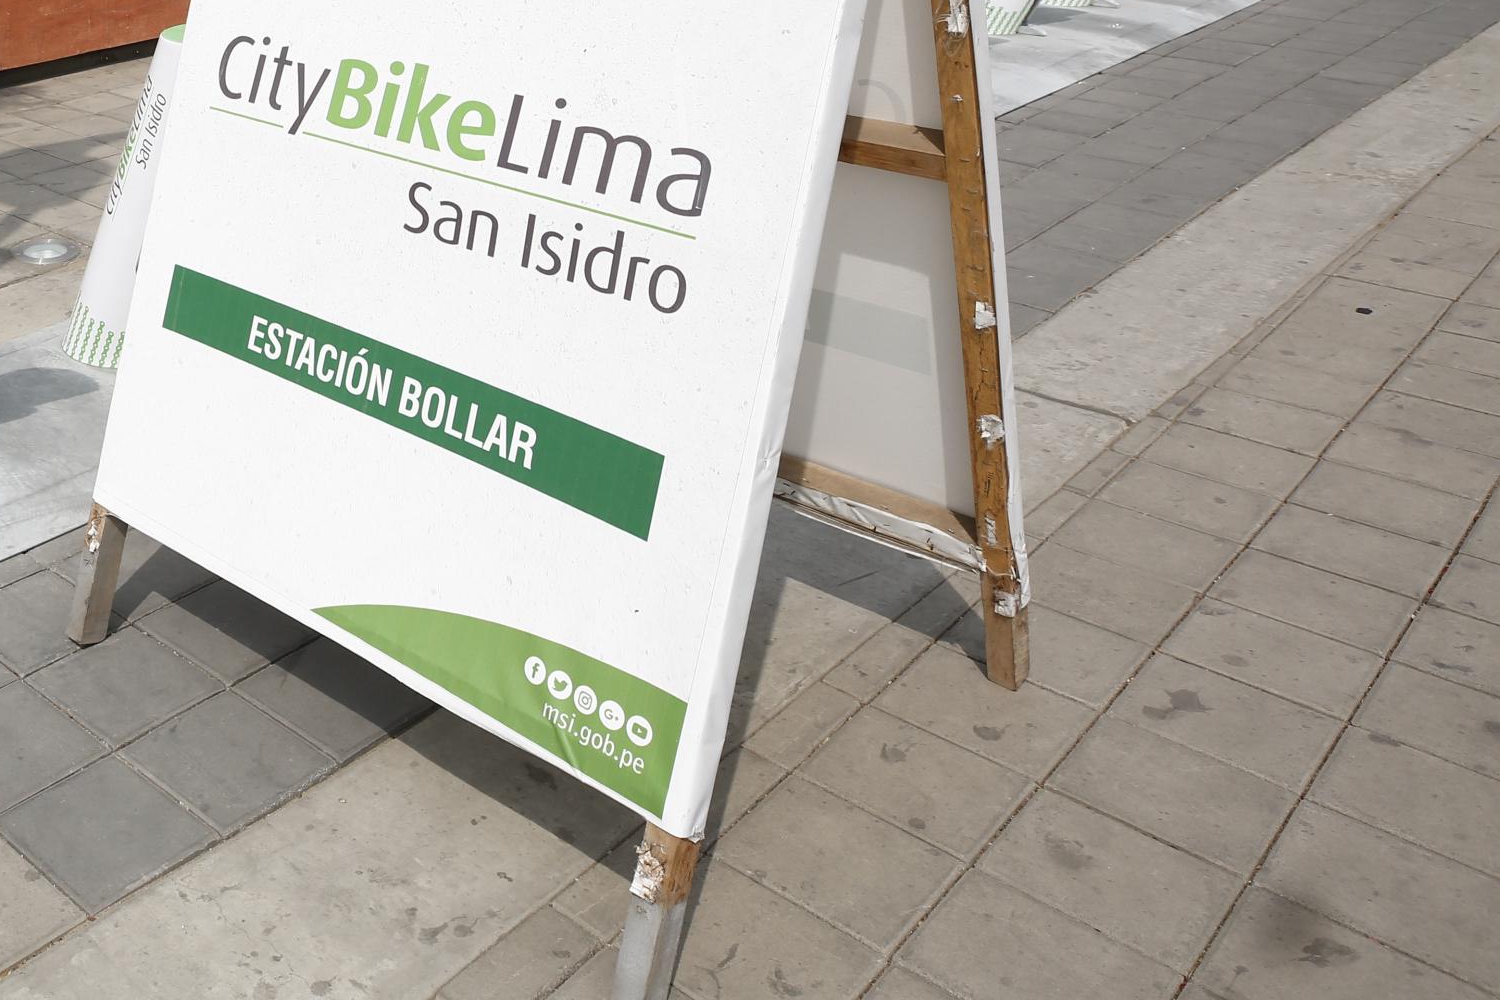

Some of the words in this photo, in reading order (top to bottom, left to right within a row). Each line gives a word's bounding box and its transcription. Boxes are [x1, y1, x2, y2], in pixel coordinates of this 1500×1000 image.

[135, 139, 153, 170] San
[144, 93, 167, 139] Isidro
[218, 35, 712, 218] CityBikeLima
[403, 181, 499, 258] San
[521, 214, 687, 314] Isidro
[247, 314, 393, 407] ESTACIÓN
[398, 375, 538, 471] BOLLAR
[542, 702, 645, 774] msi.gob.pe
